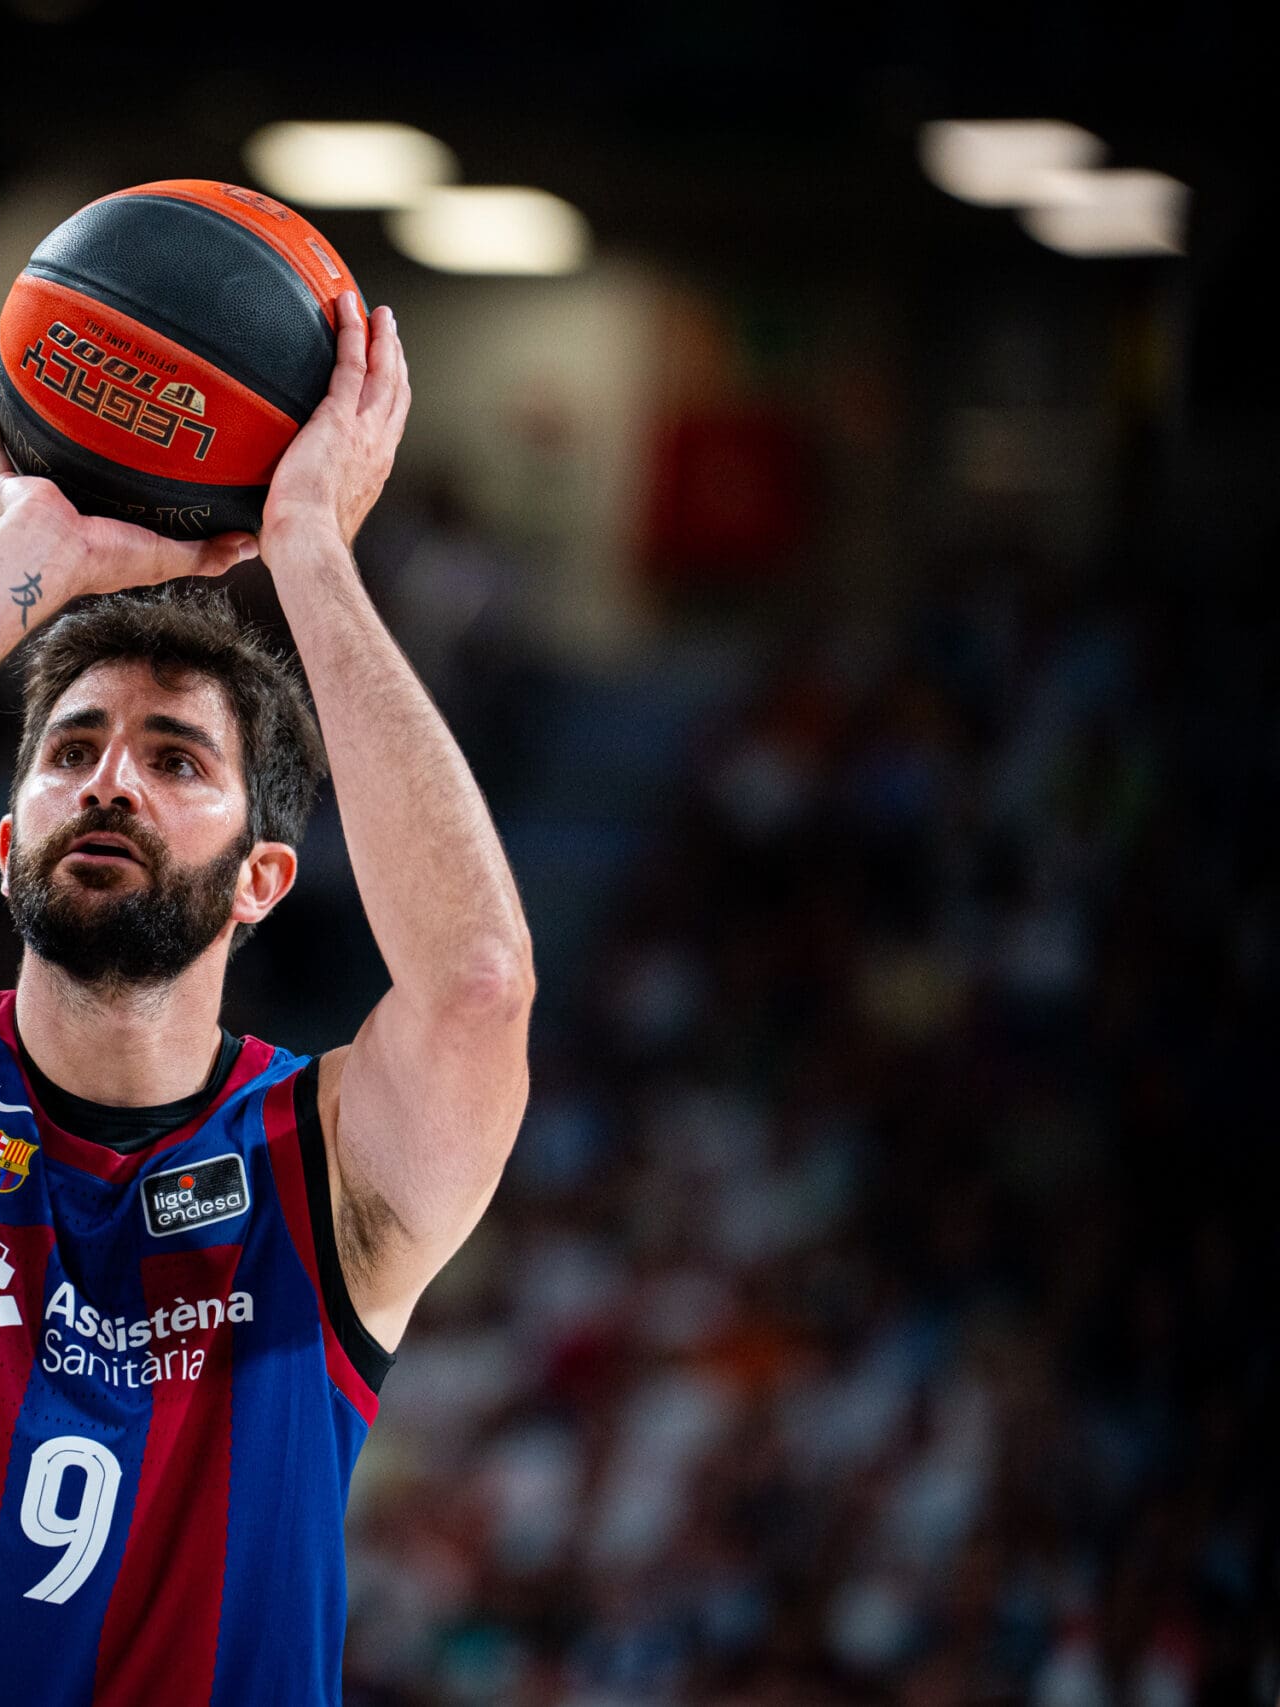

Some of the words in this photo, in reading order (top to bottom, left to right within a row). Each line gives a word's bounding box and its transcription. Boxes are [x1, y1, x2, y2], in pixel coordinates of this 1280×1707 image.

[85, 319, 106, 335] BALL
[106, 331, 131, 353] GAME
[47, 321, 160, 395] 1000
[130, 344, 179, 375] OFFICIAL
[21, 339, 217, 461] LEGACY
[153, 1189, 193, 1210] liga
[158, 1193, 241, 1226] endesa
[42, 1329, 205, 1388] Sanitària
[20, 1435, 123, 1605] 9
